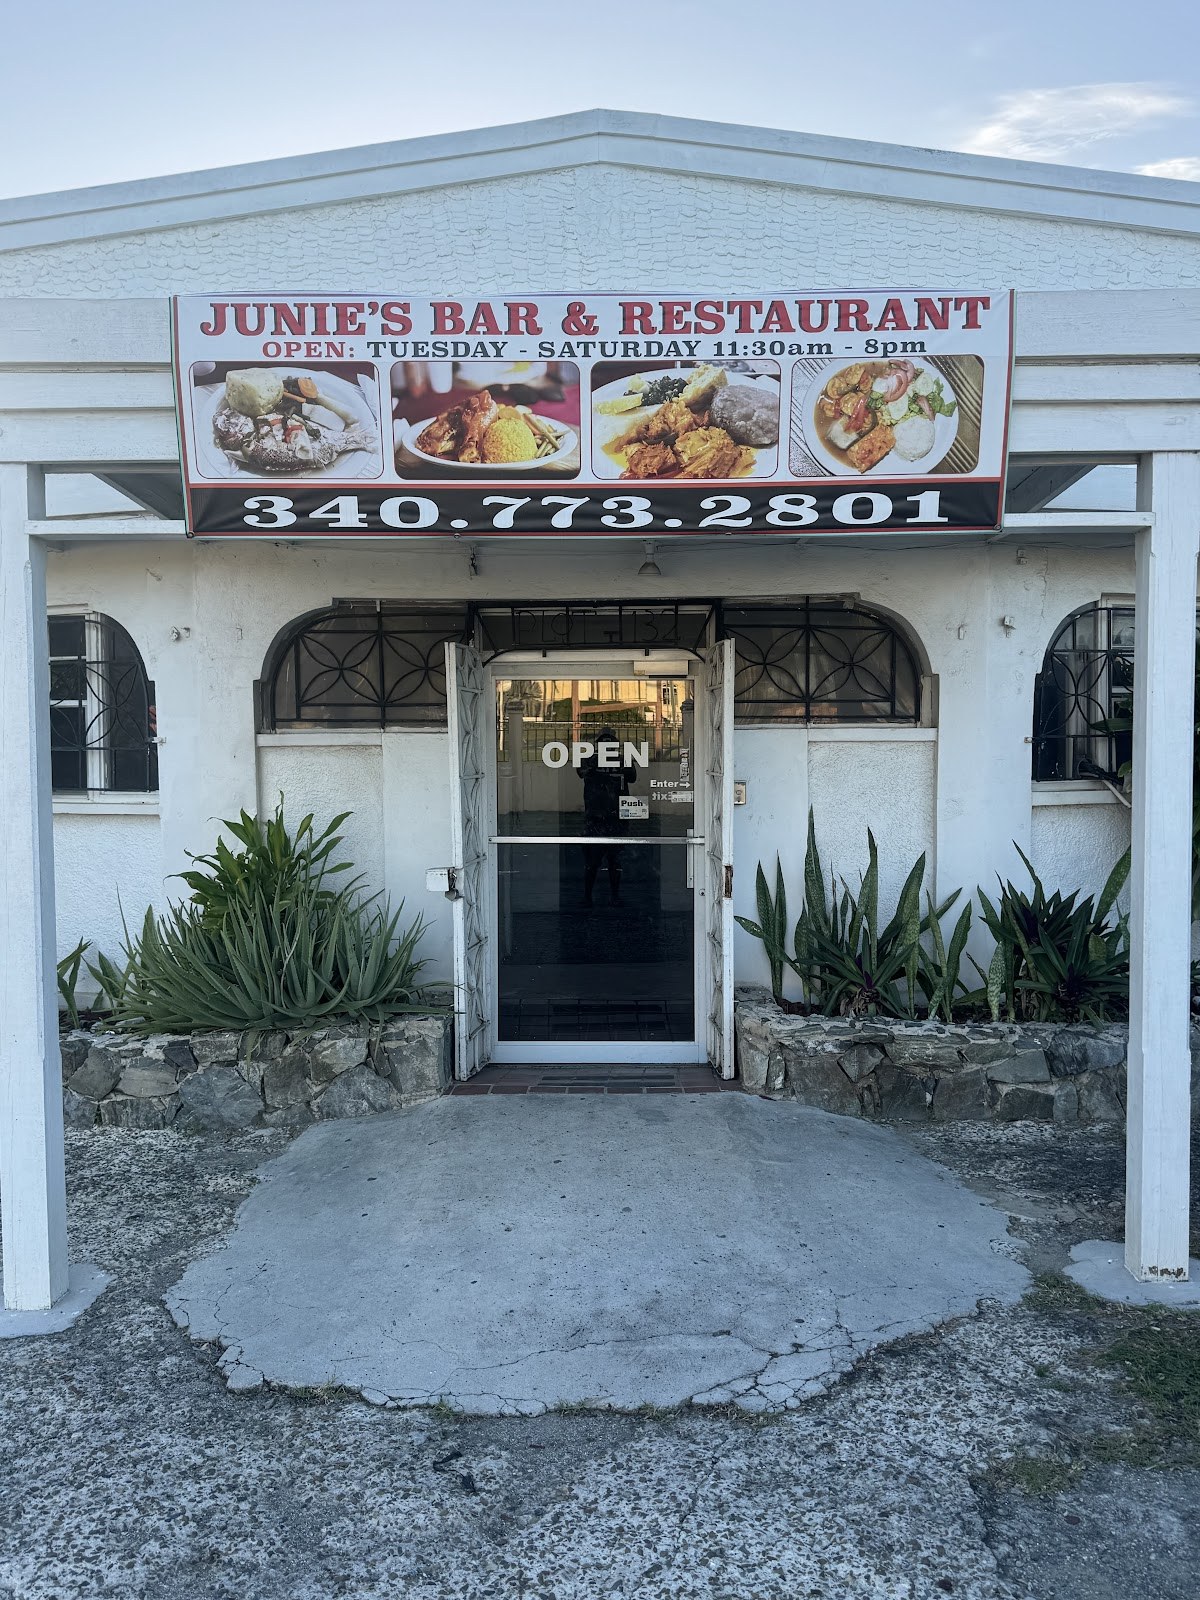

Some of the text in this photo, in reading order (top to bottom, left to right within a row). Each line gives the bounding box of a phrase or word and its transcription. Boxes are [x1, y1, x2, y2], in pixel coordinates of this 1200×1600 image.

[200, 297, 990, 336] JUNIE'S BAR & RESTAURANT
[262, 341, 355, 358] OPEN:
[367, 341, 508, 358] TUESDAY
[538, 340, 701, 358] SATURDAY
[713, 338, 833, 357] 11:30am
[864, 339, 927, 358] 8pm
[242, 491, 949, 529] 340.773.2801
[541, 741, 649, 769] OPEN
[650, 779, 679, 788] Enter
[620, 799, 643, 807] Push
